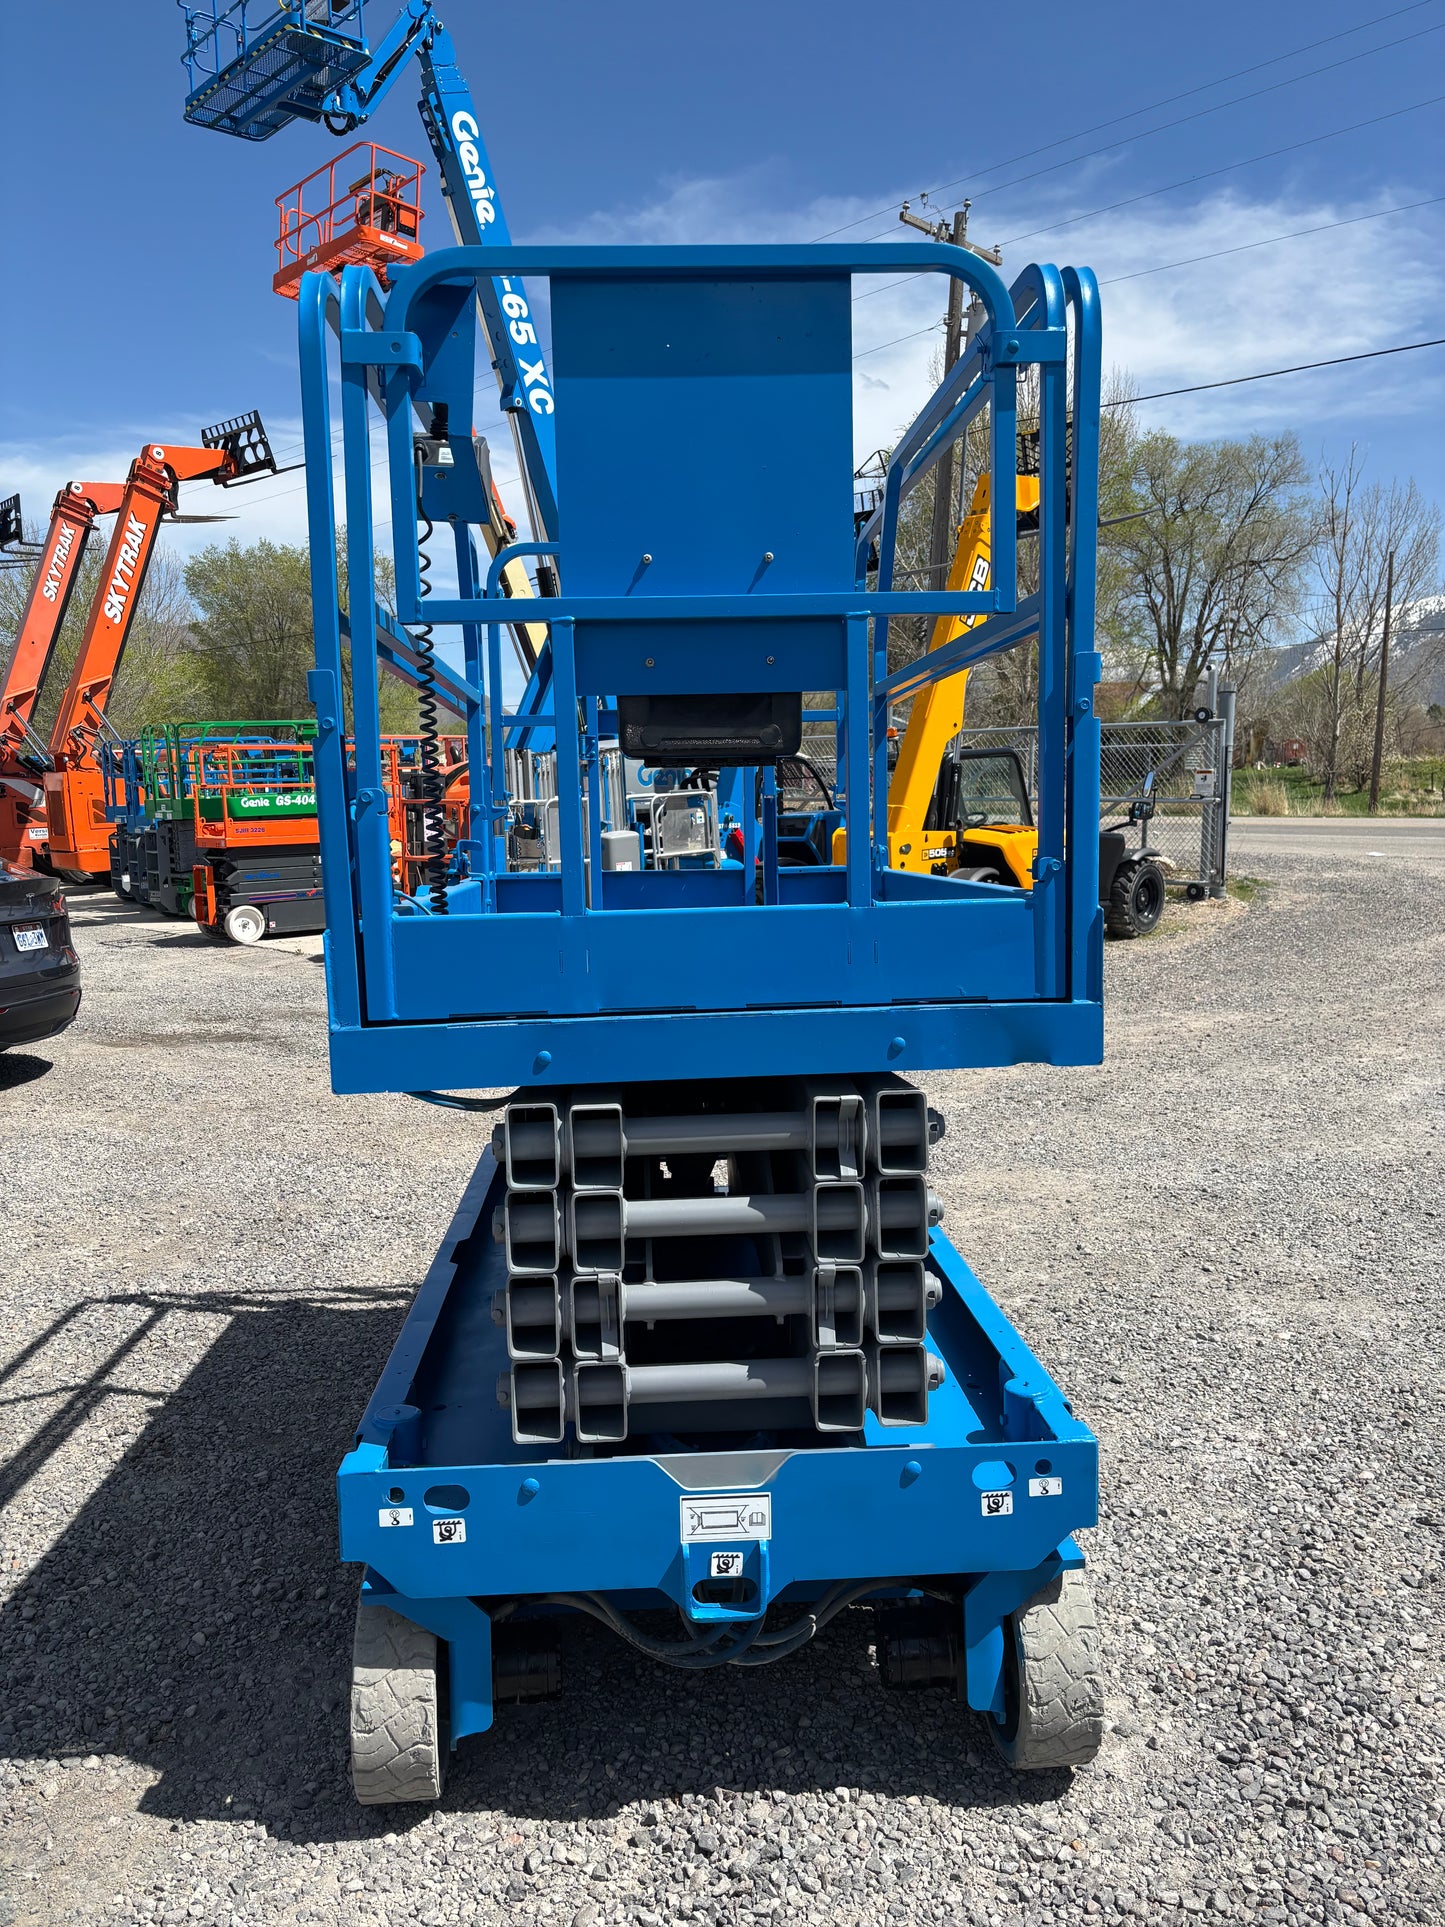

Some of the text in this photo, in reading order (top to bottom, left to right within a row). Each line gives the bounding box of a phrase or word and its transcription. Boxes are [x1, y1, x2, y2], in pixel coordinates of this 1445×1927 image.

[452, 110, 496, 225] Genie
[499, 276, 555, 416] -65 XC
[43, 521, 76, 602] SKYTRAK
[104, 511, 148, 624] SKYTRAK
[240, 794, 317, 808] Genie GS-404
